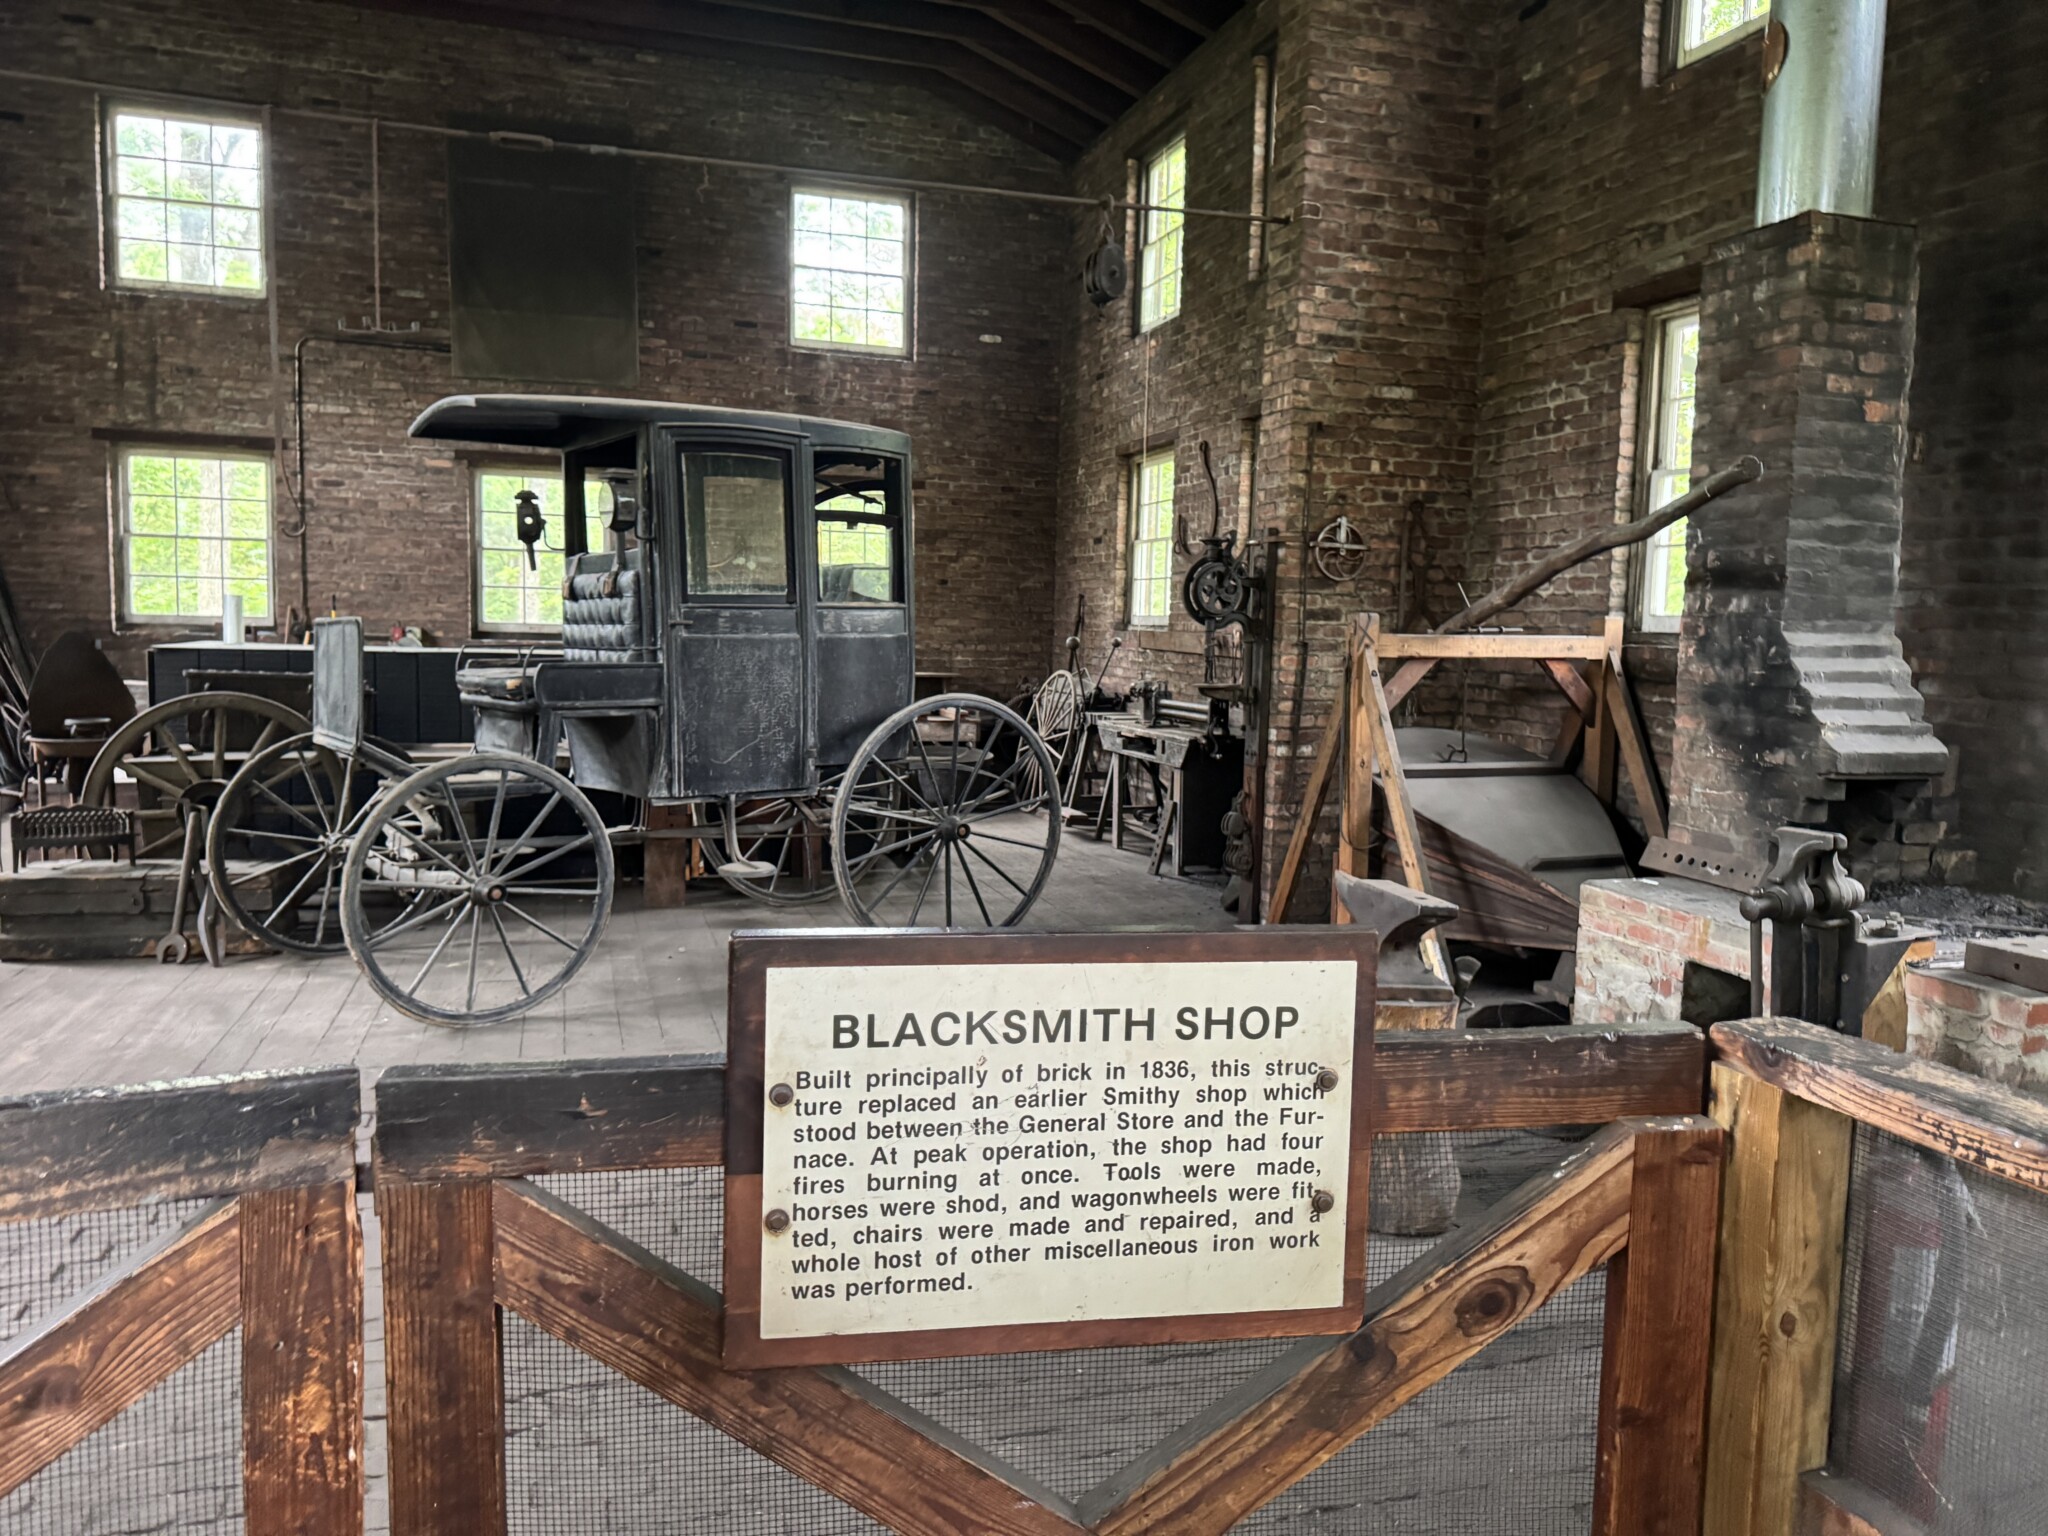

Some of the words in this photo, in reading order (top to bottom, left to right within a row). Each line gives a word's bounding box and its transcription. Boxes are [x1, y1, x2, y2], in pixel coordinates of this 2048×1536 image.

[832, 1008, 1155, 1049] BLACKSMITH
[1175, 1006, 1299, 1041] SHOP
[796, 1069, 851, 1090] Built
[866, 1065, 988, 1092] principally
[1001, 1064, 1023, 1083] of
[1037, 1063, 1091, 1083] brick
[1106, 1062, 1125, 1080] in
[1140, 1061, 1196, 1080] 1836,
[1211, 1059, 1250, 1078] this
[1265, 1060, 1325, 1076] struc-
[794, 1099, 842, 1116] ture
[858, 1093, 956, 1118] replaced
[972, 1094, 999, 1110] an
[1014, 1089, 1087, 1108] earlier
[1103, 1087, 1180, 1108] Smithy
[1196, 1085, 1247, 1105] shop
[1264, 1083, 1325, 1101] which
[793, 1122, 856, 1143] stood
[866, 1120, 962, 1140] between
[973, 1117, 1009, 1136] the
[1018, 1113, 1106, 1133] General
[1117, 1111, 1174, 1130] Store
[1184, 1110, 1223, 1129] and
[1235, 1109, 1269, 1126] the
[1280, 1108, 1324, 1125] Fur-
[793, 1150, 854, 1169] nace.
[870, 1147, 897, 1166] At
[913, 1144, 967, 1168] peak
[982, 1141, 1097, 1165] operation,
[1112, 1137, 1147, 1155] the
[1161, 1135, 1212, 1157] shop
[1227, 1133, 1266, 1152] had
[1282, 1132, 1324, 1150] four
[793, 1176, 845, 1195] fires
[867, 1172, 957, 1193] burning
[979, 1169, 1000, 1187] at
[1021, 1166, 1080, 1185] once.
[1103, 1162, 1161, 1181] Tools
[1183, 1161, 1235, 1178] were
[1257, 1157, 1321, 1177] made,
[792, 1202, 868, 1221] horses
[880, 1200, 935, 1217] were
[946, 1193, 1007, 1215] shod,
[1019, 1191, 1060, 1211] and
[1072, 1185, 1217, 1211] wagonwheels
[1229, 1184, 1280, 1201] were
[792, 1228, 836, 1249] ted,
[853, 1225, 923, 1245] chairs
[938, 1222, 994, 1240] were
[1009, 1216, 1070, 1237] made
[1085, 1213, 1124, 1233] and
[1140, 1210, 1238, 1233] repaired,
[1255, 1207, 1294, 1225] and
[1309, 1210, 1320, 1223] a
[791, 1253, 860, 1274] whole
[874, 1250, 922, 1270] host
[936, 1247, 958, 1266] of
[971, 1245, 1030, 1265] other
[1045, 1236, 1198, 1261] miscellaneous
[1213, 1235, 1255, 1252] iron
[1270, 1231, 1320, 1250] work
[791, 1282, 835, 1299] was
[845, 1272, 973, 1301] performed.
